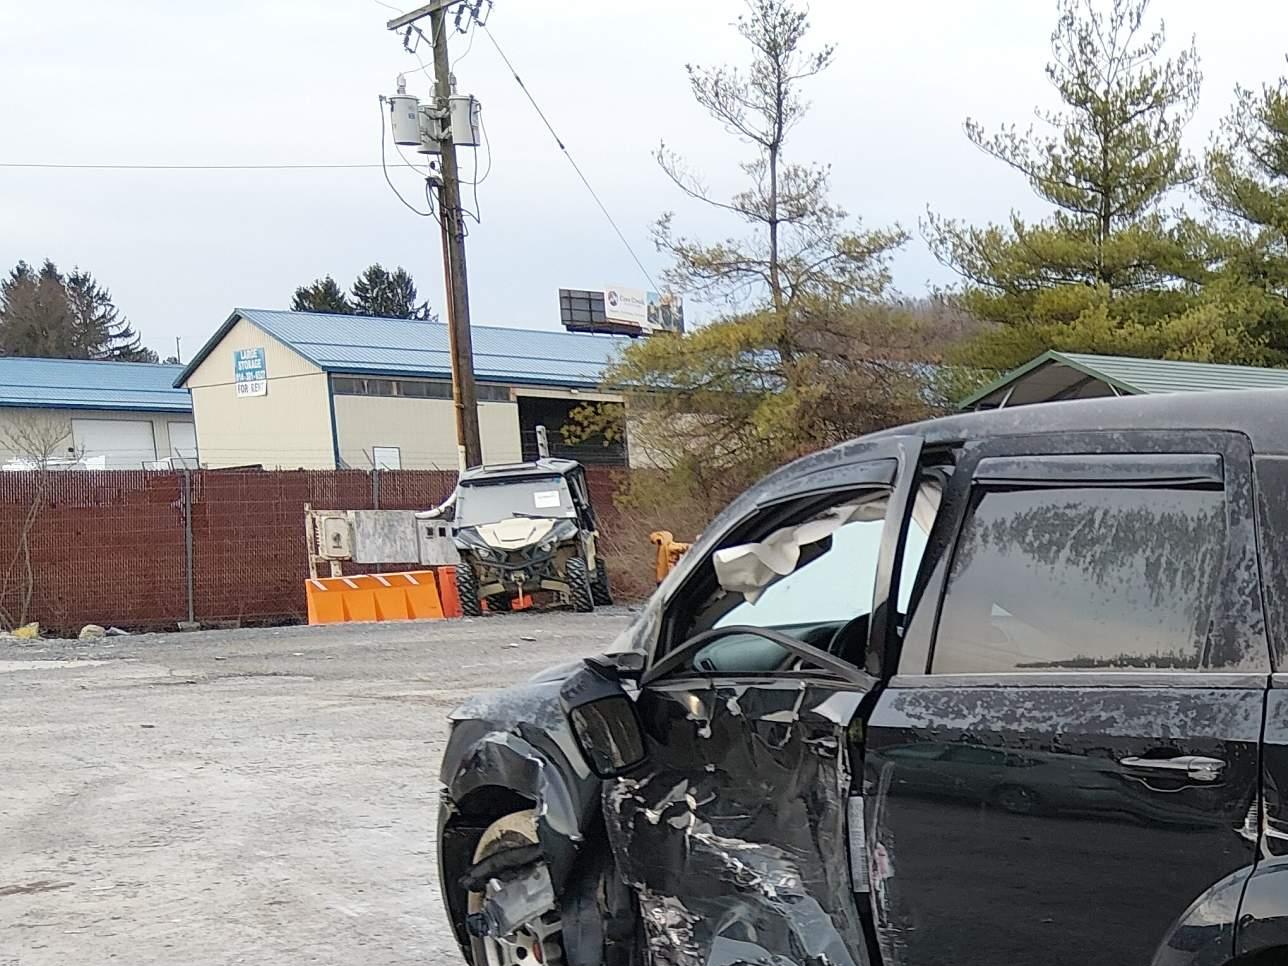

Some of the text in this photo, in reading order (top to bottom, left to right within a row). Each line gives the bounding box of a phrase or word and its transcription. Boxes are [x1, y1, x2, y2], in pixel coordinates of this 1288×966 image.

[238, 359, 262, 370] STORAGE
[238, 383, 264, 394] FOR RENT
